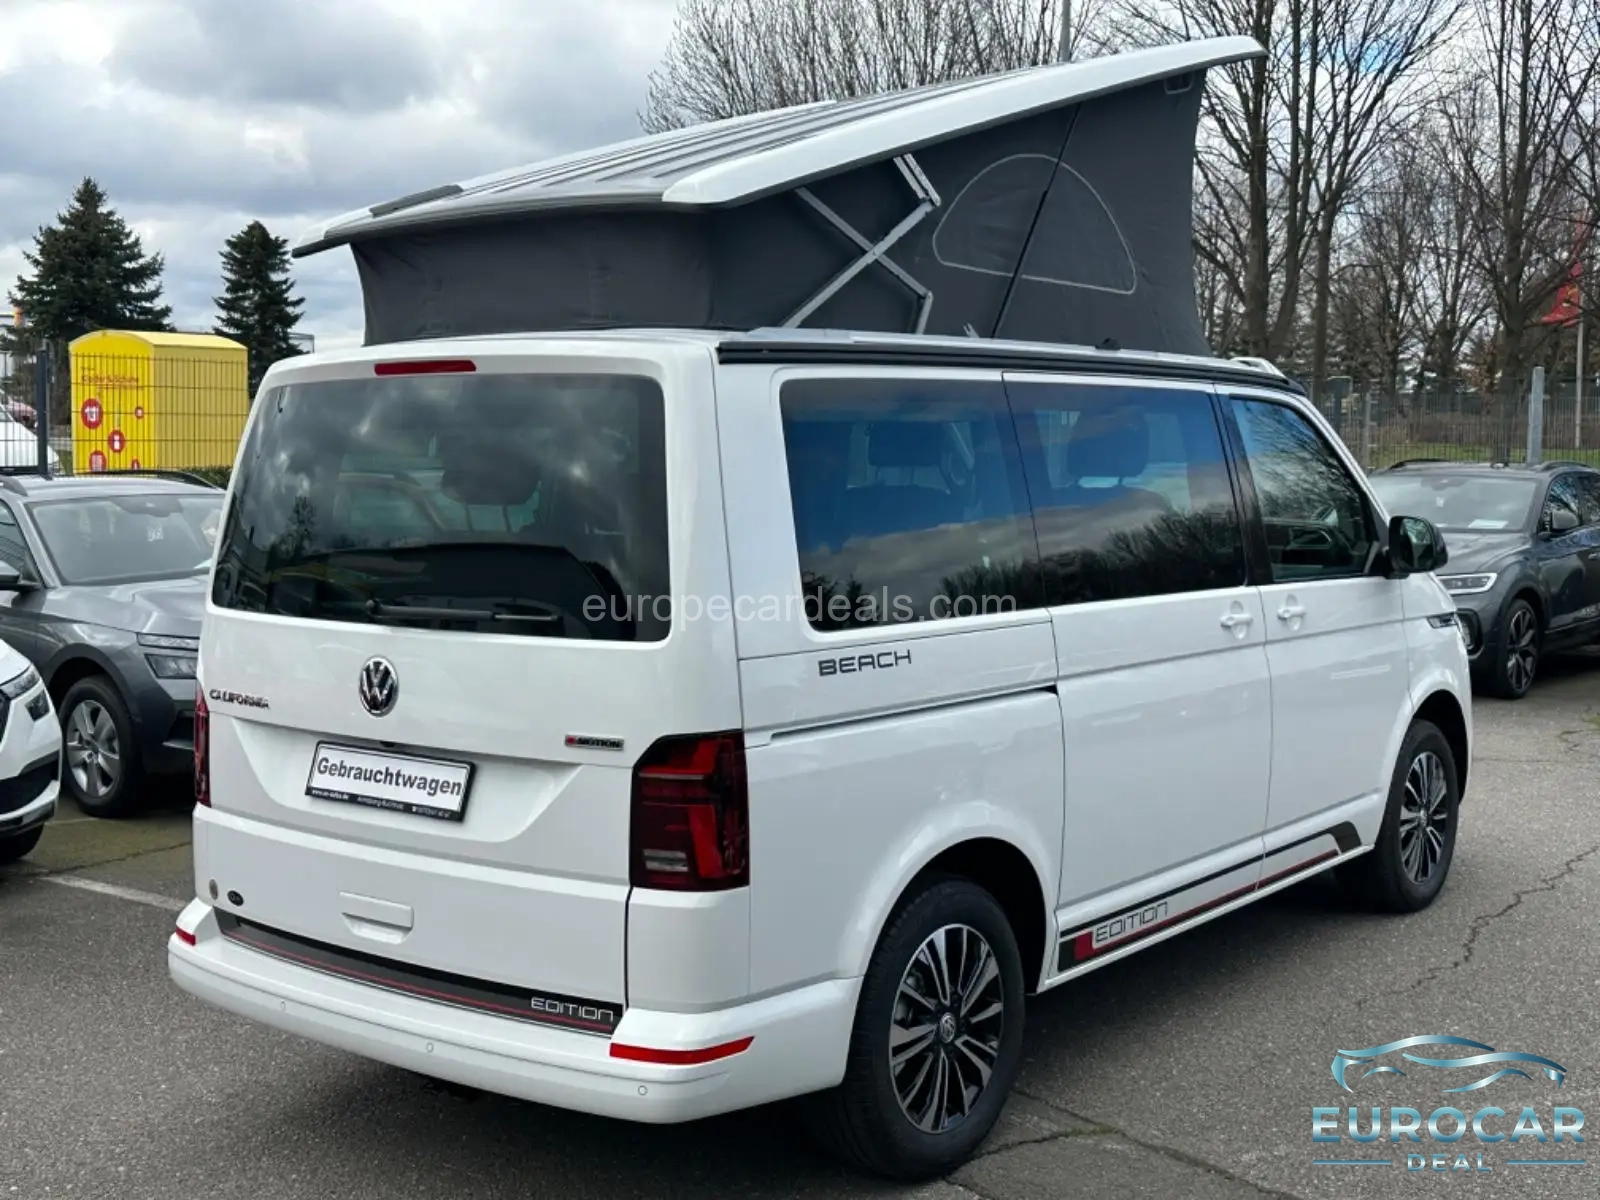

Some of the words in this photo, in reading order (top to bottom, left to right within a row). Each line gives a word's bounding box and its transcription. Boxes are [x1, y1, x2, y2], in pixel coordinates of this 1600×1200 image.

[817, 649, 912, 677] BEACH
[209, 688, 271, 710] CALIFORNIA
[316, 757, 463, 797] Gebrauchtwagen
[1095, 901, 1169, 943] EDITION
[531, 997, 614, 1022] EDITION
